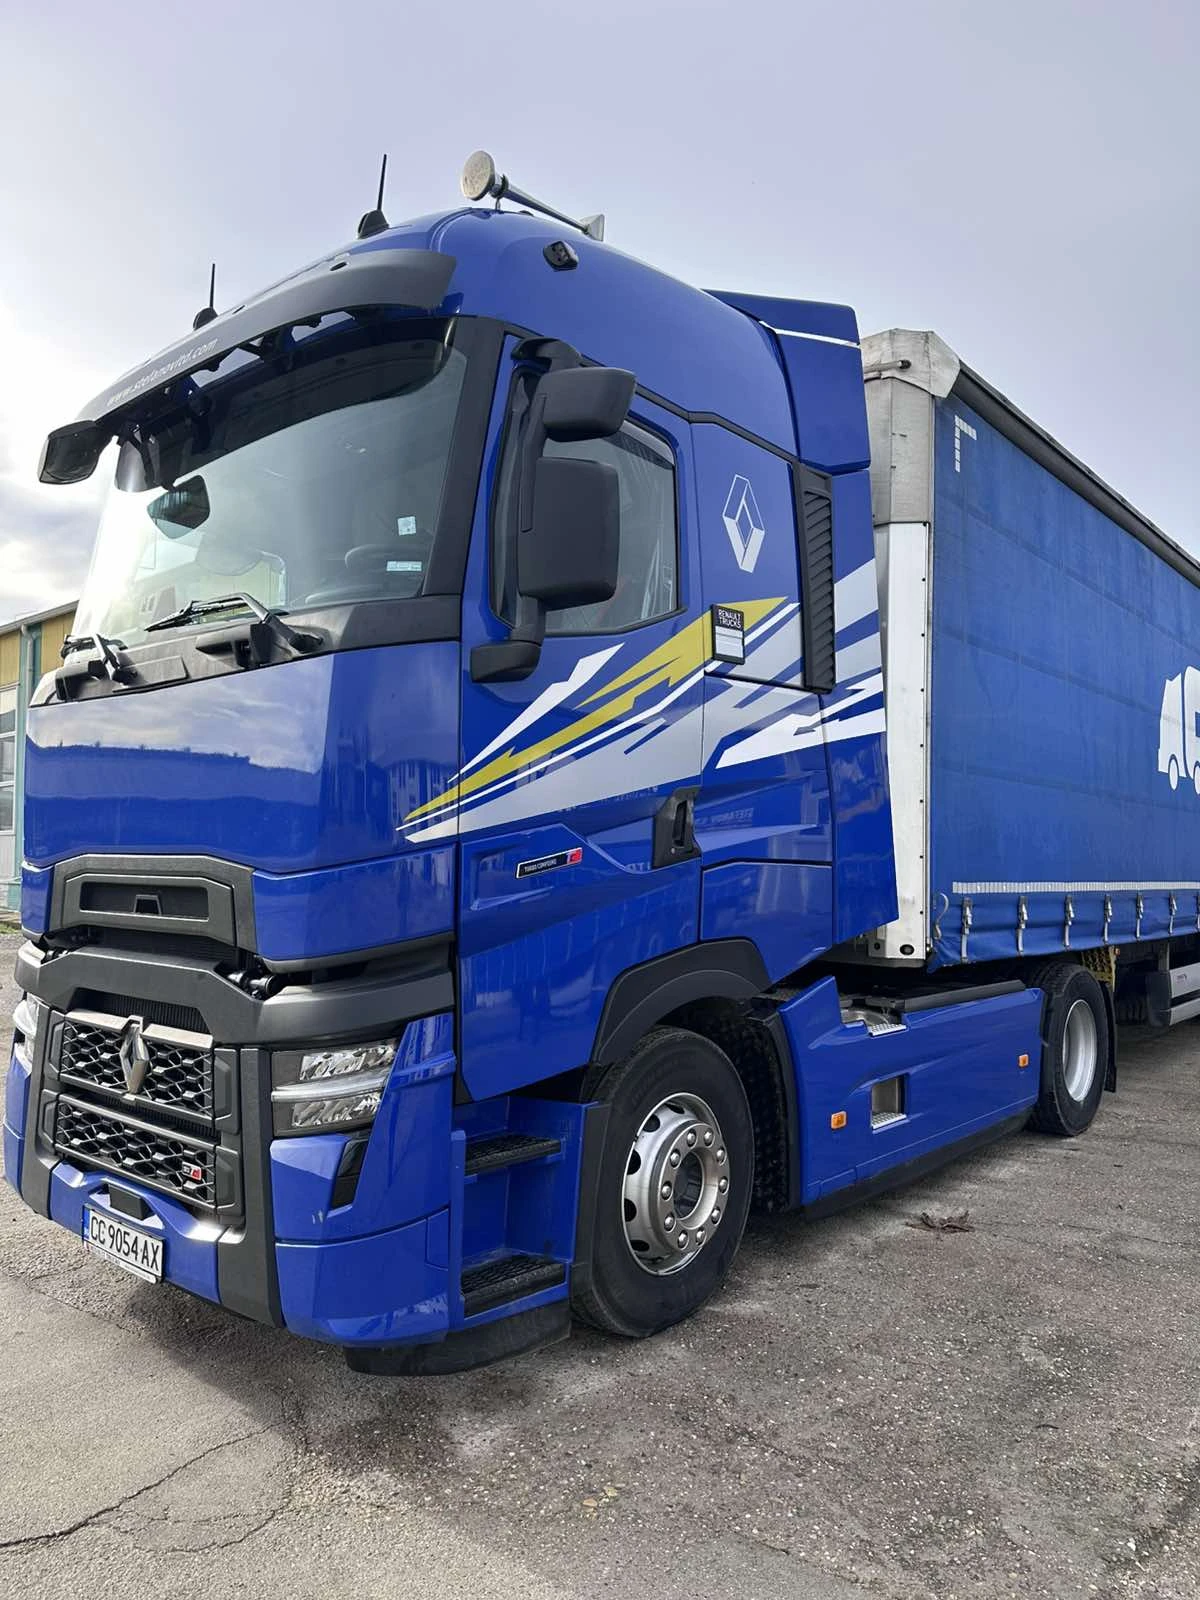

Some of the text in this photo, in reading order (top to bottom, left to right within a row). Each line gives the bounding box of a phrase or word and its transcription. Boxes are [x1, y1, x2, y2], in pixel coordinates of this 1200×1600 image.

[91, 1216, 106, 1245] CC
[108, 1224, 138, 1261] 9054
[141, 1239, 160, 1271] AX
